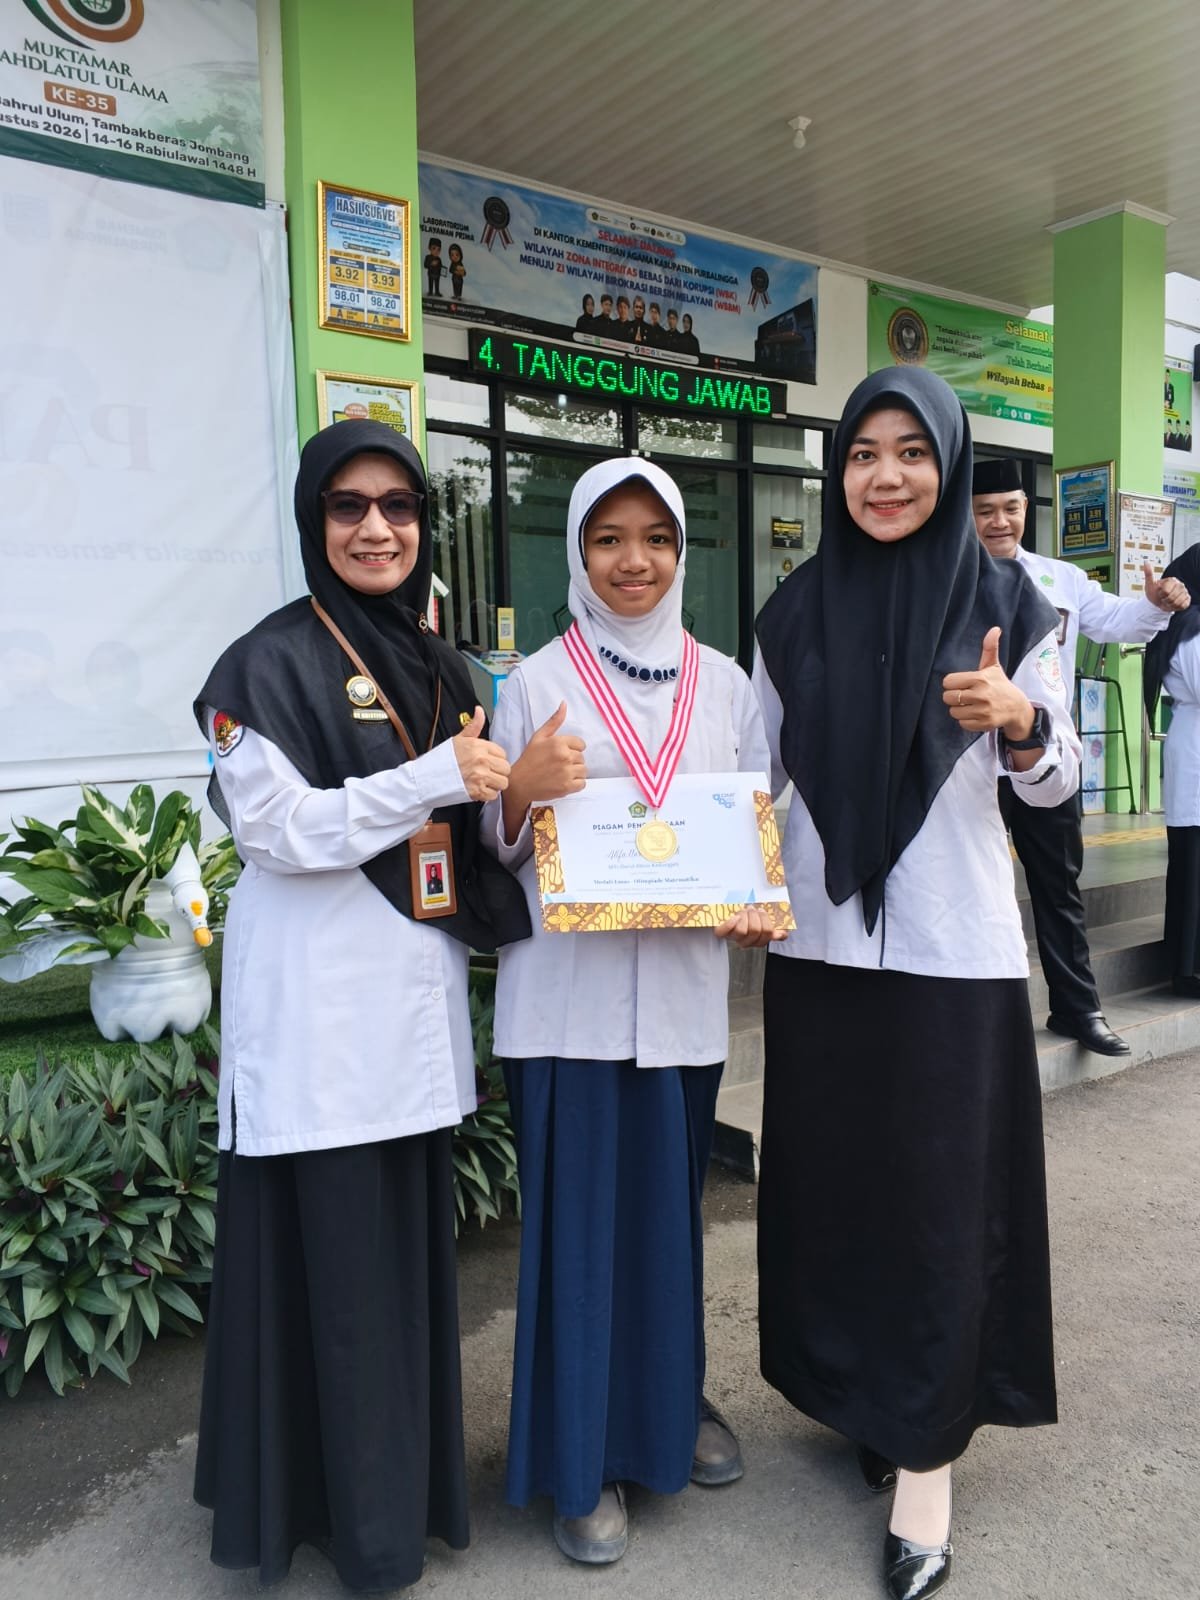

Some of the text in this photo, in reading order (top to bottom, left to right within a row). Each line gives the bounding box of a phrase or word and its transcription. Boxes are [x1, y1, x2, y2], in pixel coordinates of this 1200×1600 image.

[24, 38, 132, 77] MUKTAMAR
[51, 85, 109, 111] KE-35
[106, 76, 169, 103] ULAMA
[0, 96, 249, 164] ahrul Ulum, Tambakberas Jombang
[43, 121, 82, 139] 2026
[92, 132, 132, 150] 14-16
[136, 142, 209, 167] Rabiulawal
[212, 159, 244, 176] 1448
[247, 168, 256, 178] H
[336, 197, 362, 215] HASIL
[523, 241, 564, 259] WILAYAH
[566, 251, 591, 266] ZONA
[593, 257, 637, 277] INTEGRITAS
[639, 269, 663, 283] BEBAS
[664, 275, 682, 288] DARI
[683, 280, 715, 296] KORUPSI
[534, 227, 739, 285] DI KANTOR KEMENTERIAN AGAMA KABUPATEN PURBALINGGA
[335, 266, 359, 281] 3.92
[371, 273, 395, 287] 3.93
[520, 254, 554, 270] MENUJU
[566, 265, 604, 282] WILAYAH
[605, 274, 648, 292] BIROKRASI
[649, 285, 675, 299] BERSIH
[676, 292, 713, 307] MELAYANI
[335, 290, 360, 304] 98.01
[371, 296, 396, 310] 98.20
[1005, 320, 1049, 343] Selamat
[478, 336, 771, 413] 4. TANGGUNG JAWAB
[987, 371, 1045, 391] Wilayah Bebas
[592, 823, 624, 831] PIAGAM
